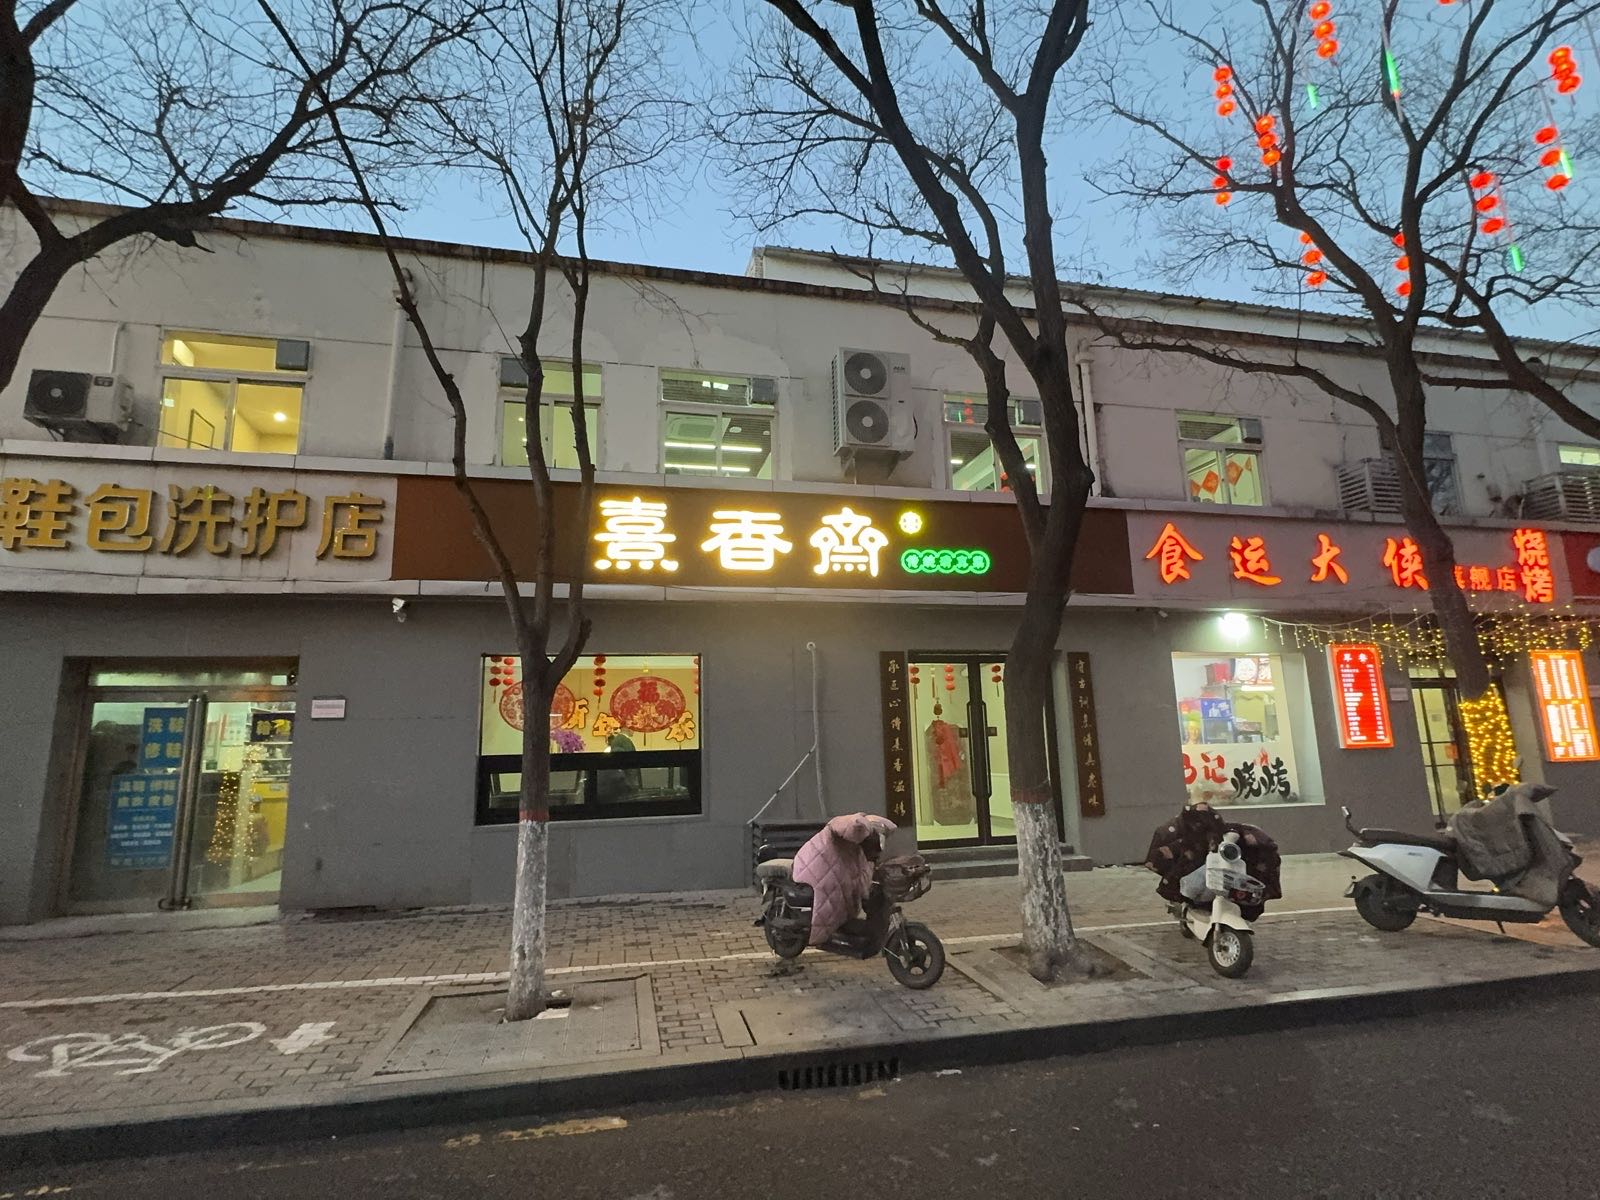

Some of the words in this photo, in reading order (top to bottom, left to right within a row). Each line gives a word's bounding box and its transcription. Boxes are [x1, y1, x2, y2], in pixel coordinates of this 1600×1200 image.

[0, 478, 385, 560] 鞋包洗护店
[1146, 522, 1429, 591] 食运大侠
[1513, 528, 1553, 603] 烧烤
